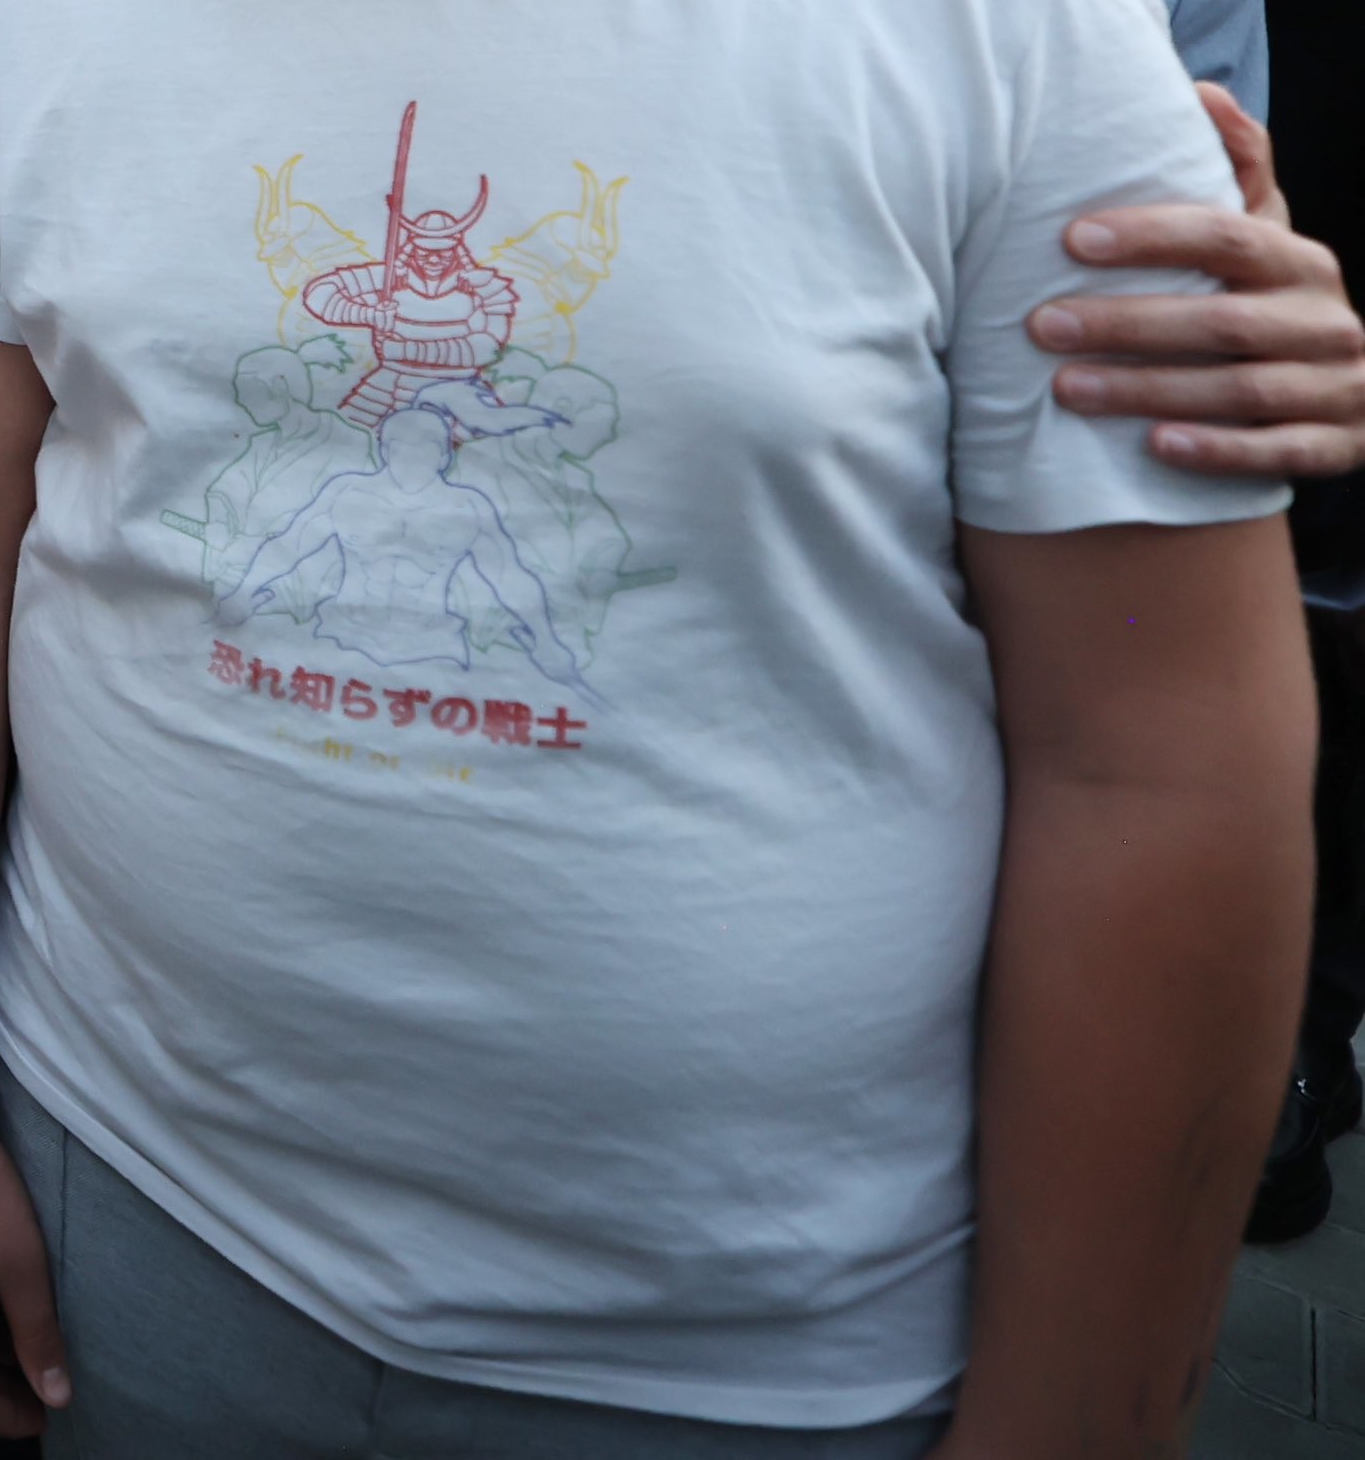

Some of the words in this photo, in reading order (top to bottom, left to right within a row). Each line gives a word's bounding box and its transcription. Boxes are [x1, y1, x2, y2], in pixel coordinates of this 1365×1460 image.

[207, 640, 588, 750] 恐れ知らずの戦士
